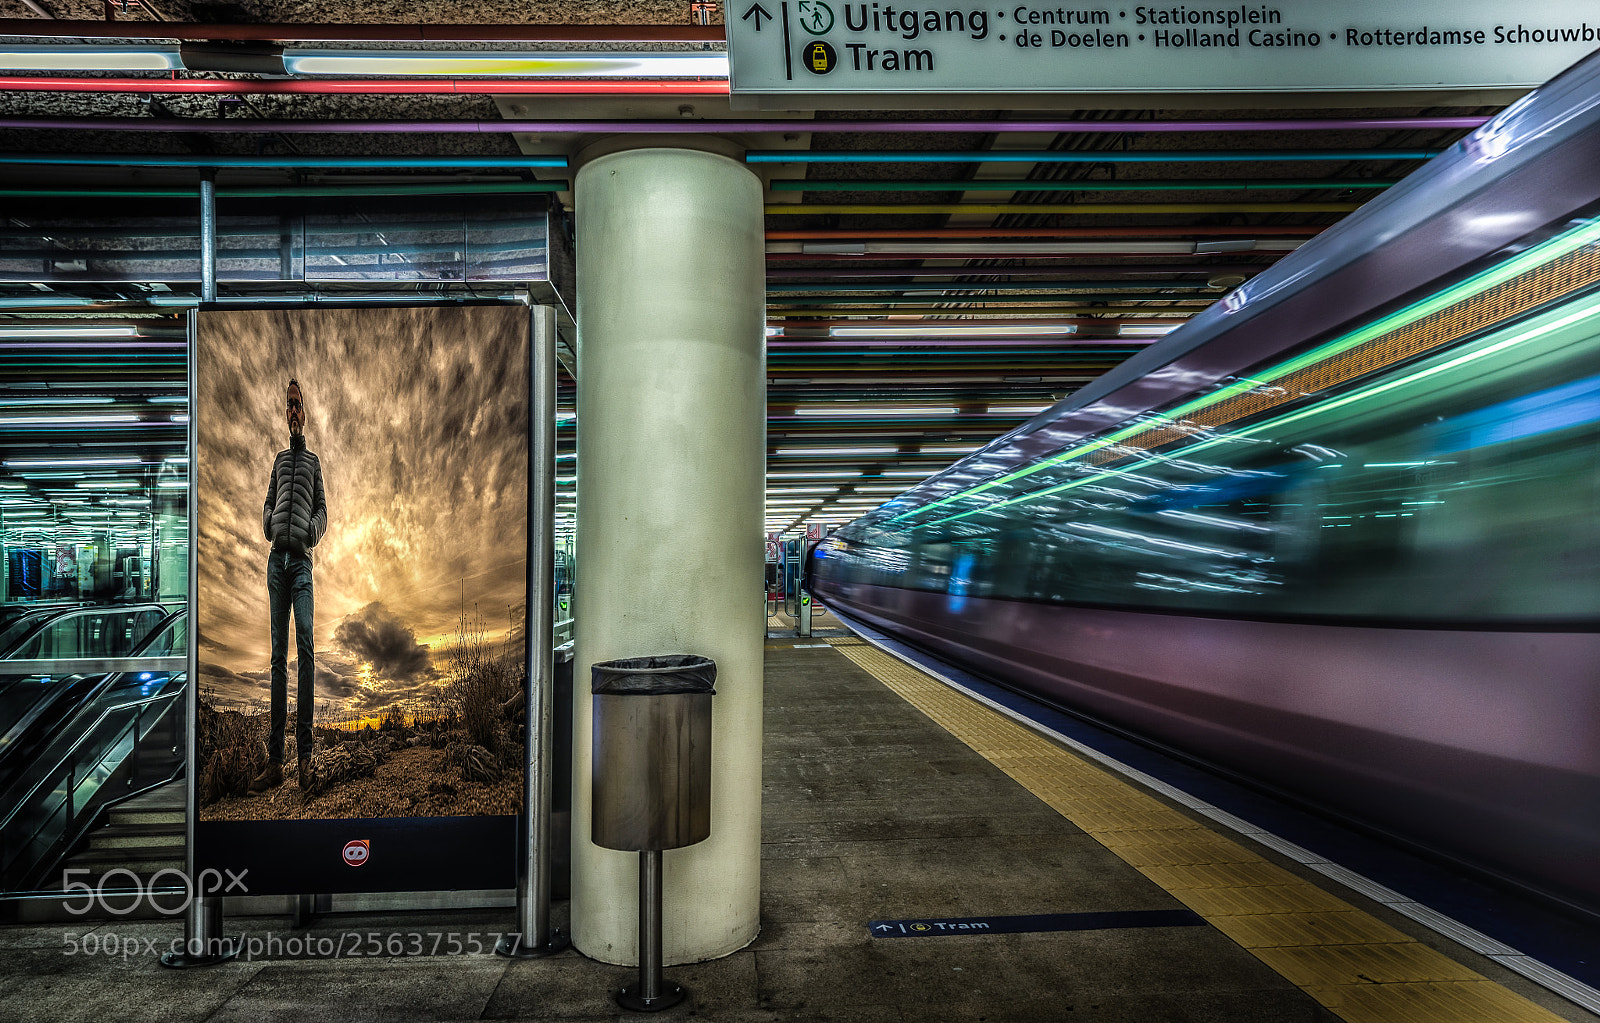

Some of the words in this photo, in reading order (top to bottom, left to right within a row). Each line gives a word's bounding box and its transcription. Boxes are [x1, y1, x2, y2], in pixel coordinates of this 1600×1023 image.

[845, 3, 988, 39] Uitgang
[1013, 6, 1110, 25] Centrum
[1136, 6, 1281, 28] Stationsplein
[1016, 29, 1043, 48] de
[1051, 29, 1129, 48] Doelen
[1155, 29, 1240, 48] Holland
[1248, 28, 1321, 47] Casino
[1346, 26, 1485, 46] Rotterdamse
[1493, 23, 1600, 45] Schouwb
[845, 43, 934, 72] Tram
[935, 921, 990, 931] Tram
